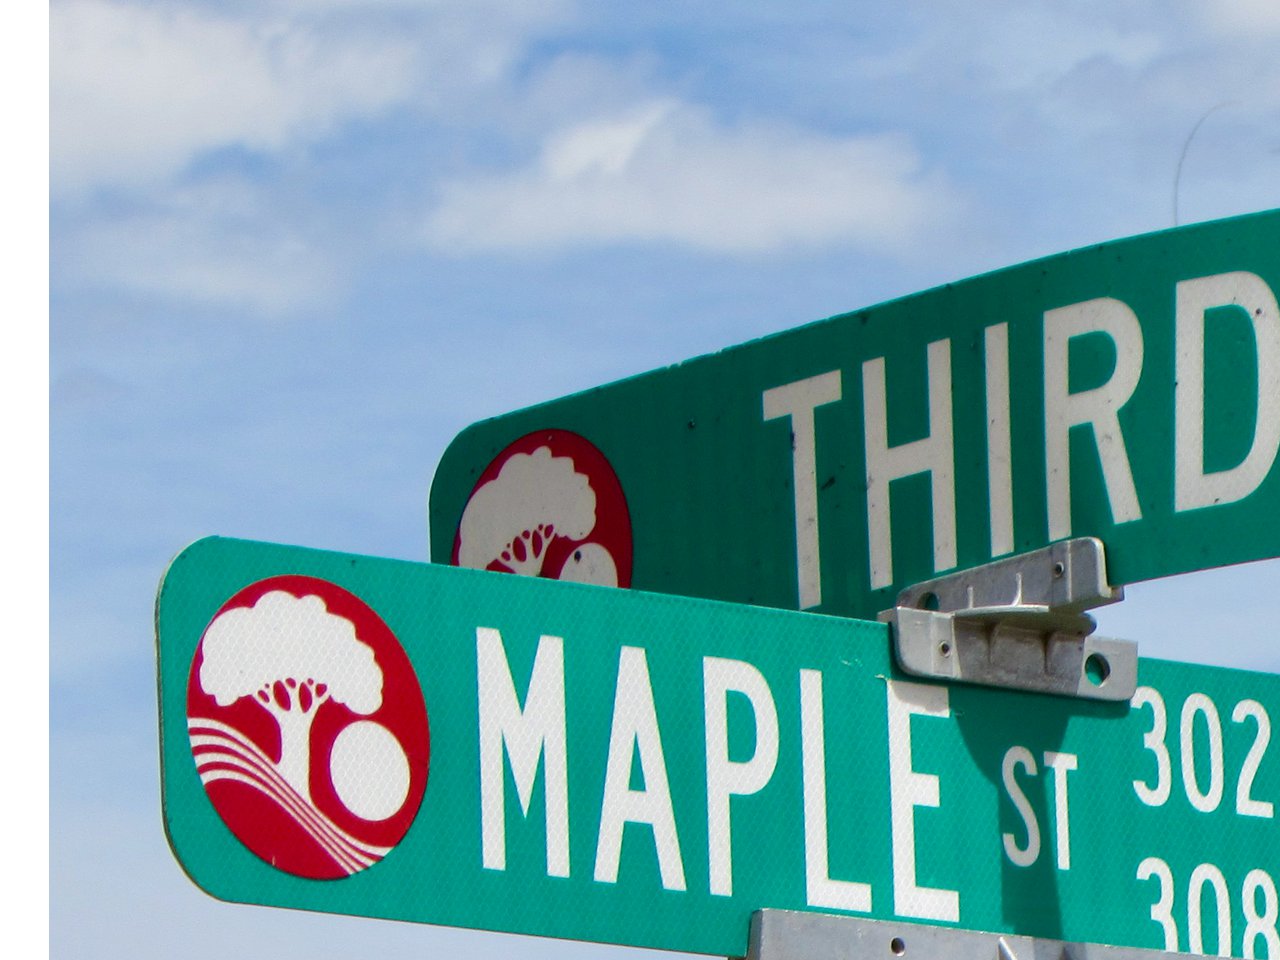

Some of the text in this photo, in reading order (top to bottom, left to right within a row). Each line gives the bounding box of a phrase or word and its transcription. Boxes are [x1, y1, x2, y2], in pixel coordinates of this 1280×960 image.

[476, 627, 1077, 921] MAPLE ST
[1132, 687, 1274, 819] 302
